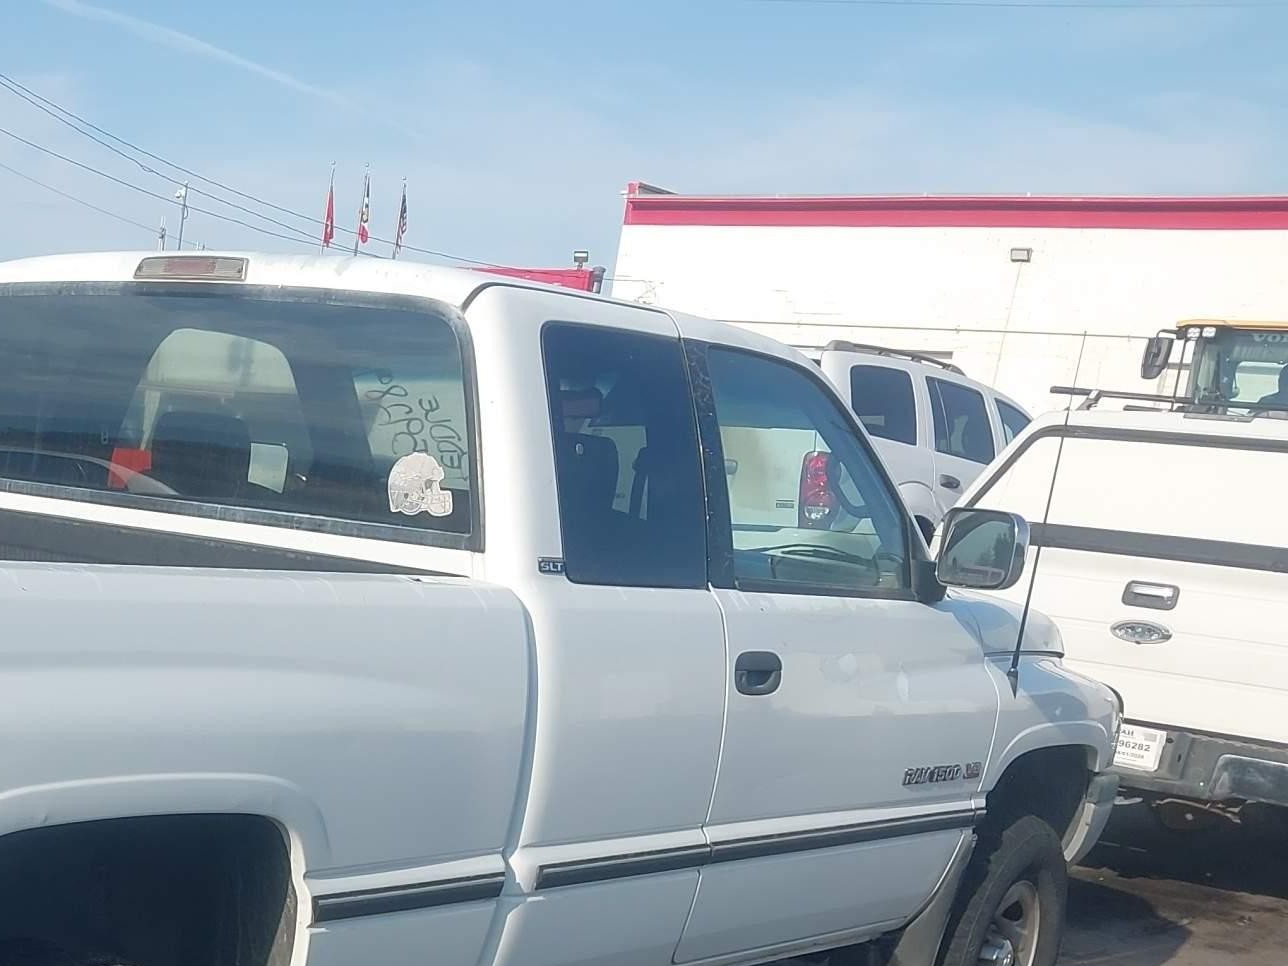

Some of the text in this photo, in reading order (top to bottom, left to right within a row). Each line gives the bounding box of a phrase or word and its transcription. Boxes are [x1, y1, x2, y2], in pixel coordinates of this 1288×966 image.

[540, 561, 564, 572] SLT
[902, 766, 931, 785] RAM
[931, 763, 962, 782] 1500
